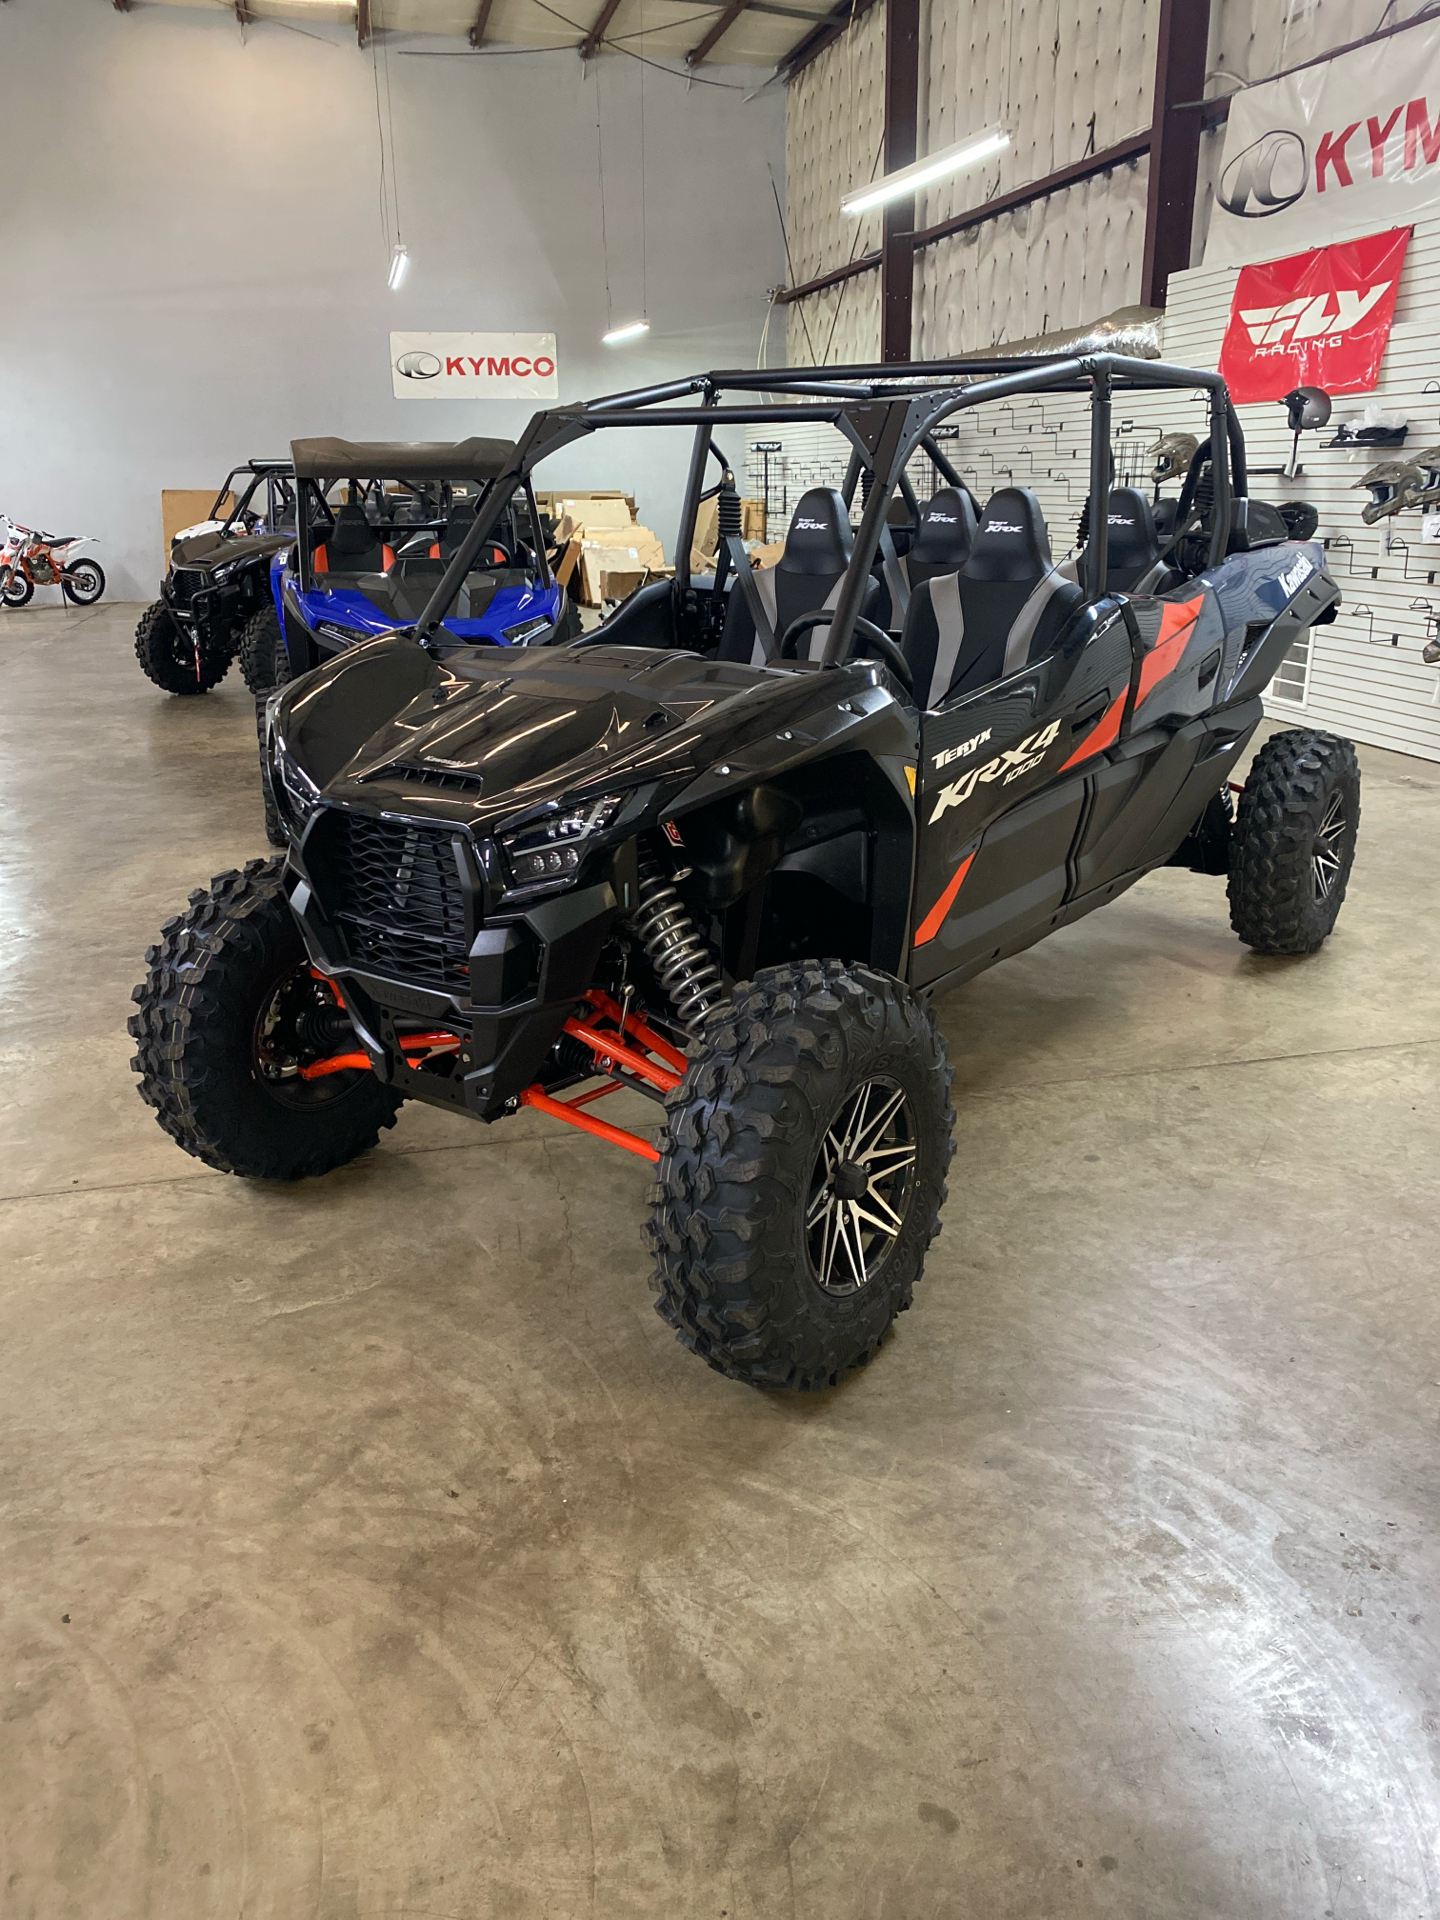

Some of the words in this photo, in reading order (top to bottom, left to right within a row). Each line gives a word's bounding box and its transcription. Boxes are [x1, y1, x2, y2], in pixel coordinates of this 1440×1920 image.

[1238, 280, 1393, 346] FLY
[1254, 335, 1342, 359] RACING
[445, 356, 555, 377] KYMCO
[794, 522, 829, 530] KRX
[984, 525, 1024, 533] KRX
[1277, 551, 1314, 599] Kawasaki
[931, 727, 993, 770] TERYX
[927, 718, 1062, 826] KRX4
[1002, 750, 1047, 787] 1000
